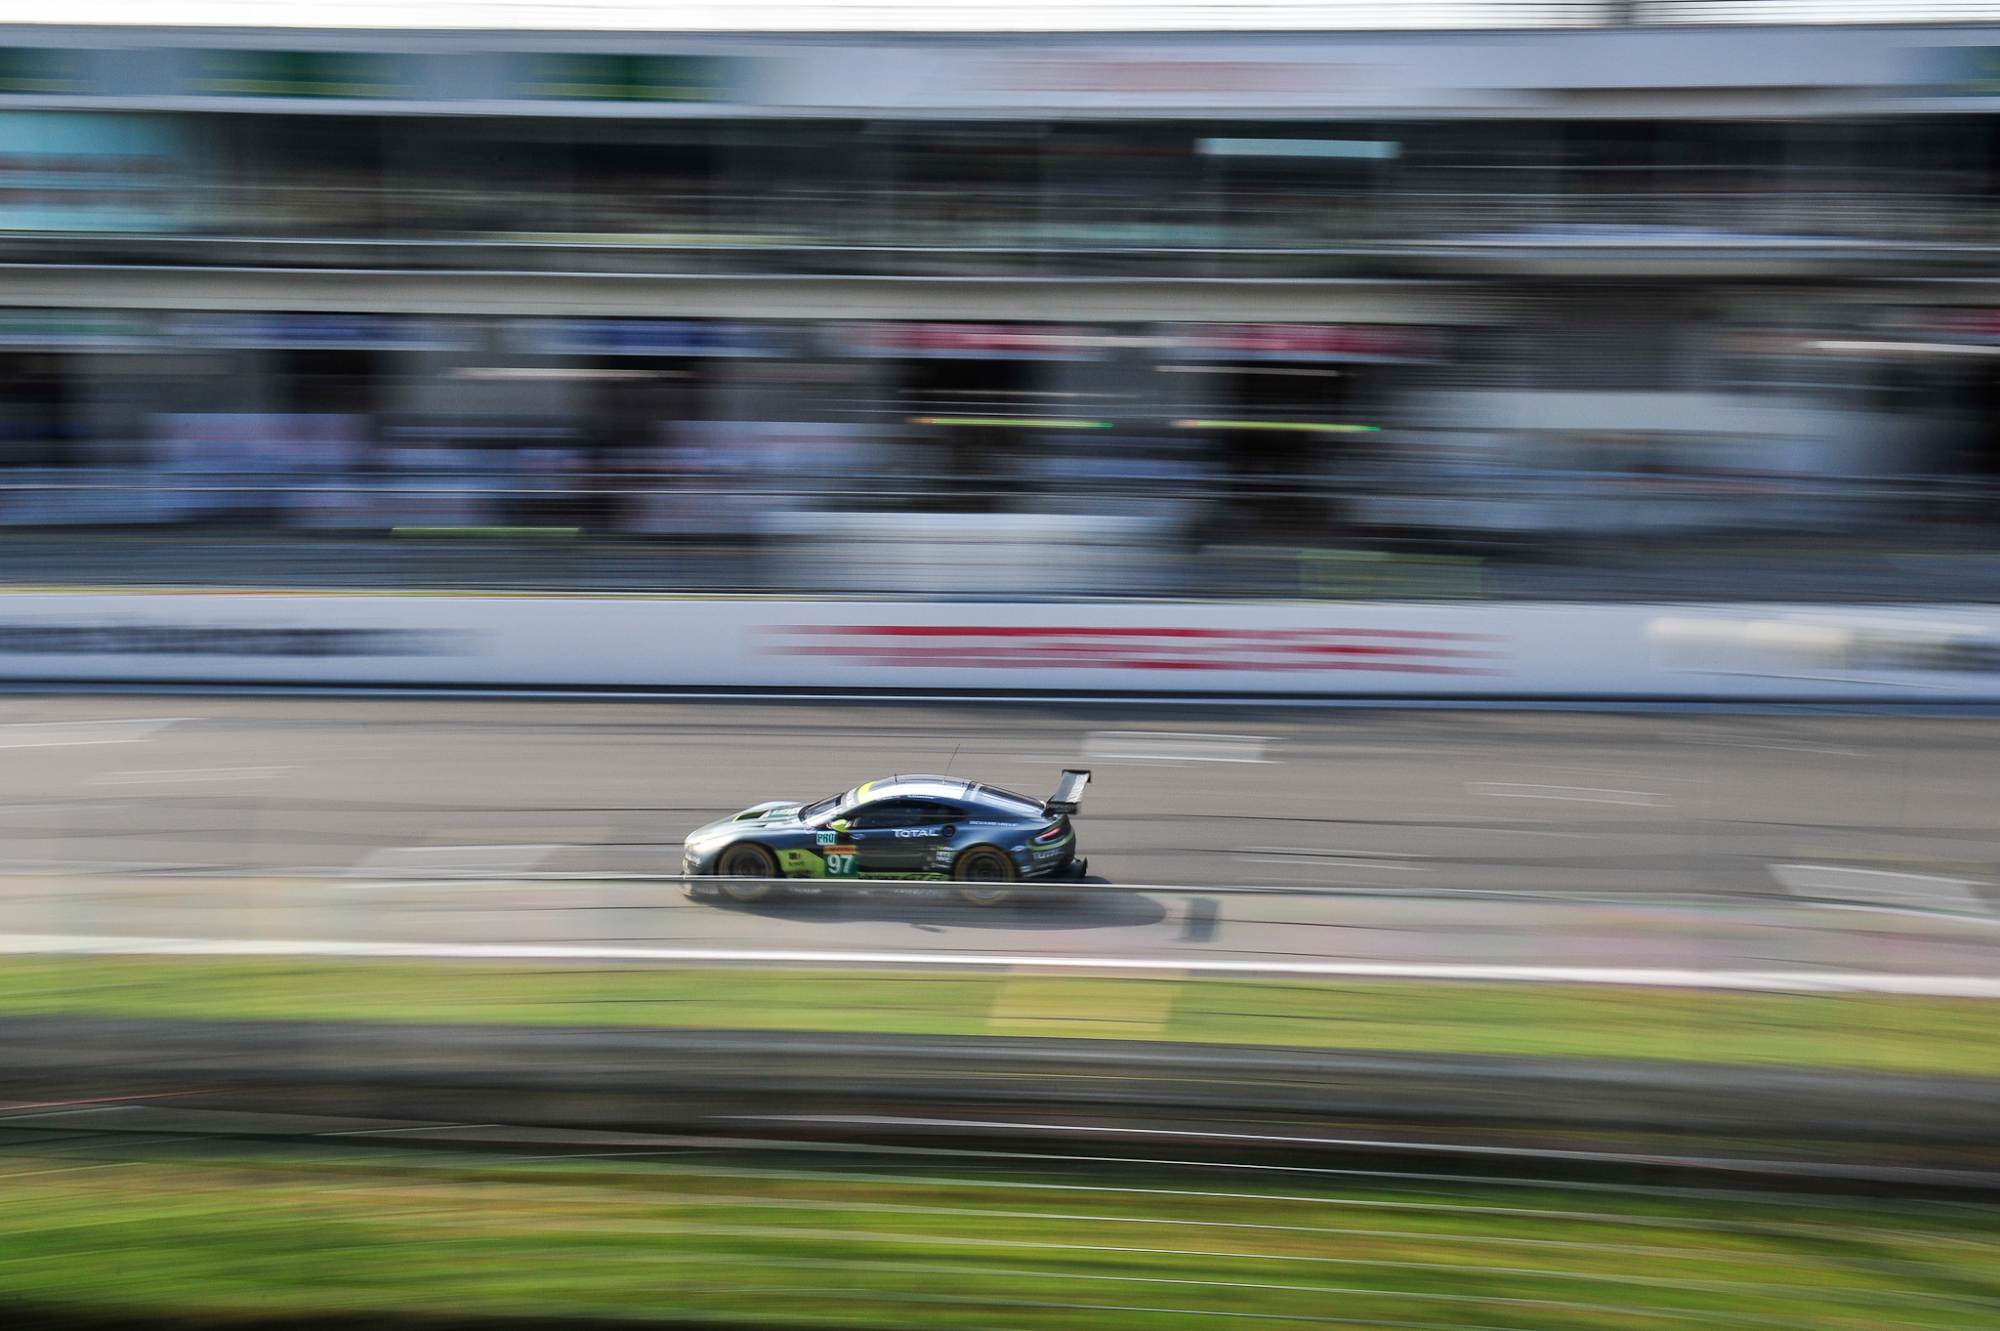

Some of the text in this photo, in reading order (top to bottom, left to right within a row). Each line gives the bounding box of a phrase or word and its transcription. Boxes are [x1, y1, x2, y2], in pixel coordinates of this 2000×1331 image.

[817, 833, 834, 843] PRO
[891, 828, 940, 838] TOTAL
[827, 854, 853, 874] 97
